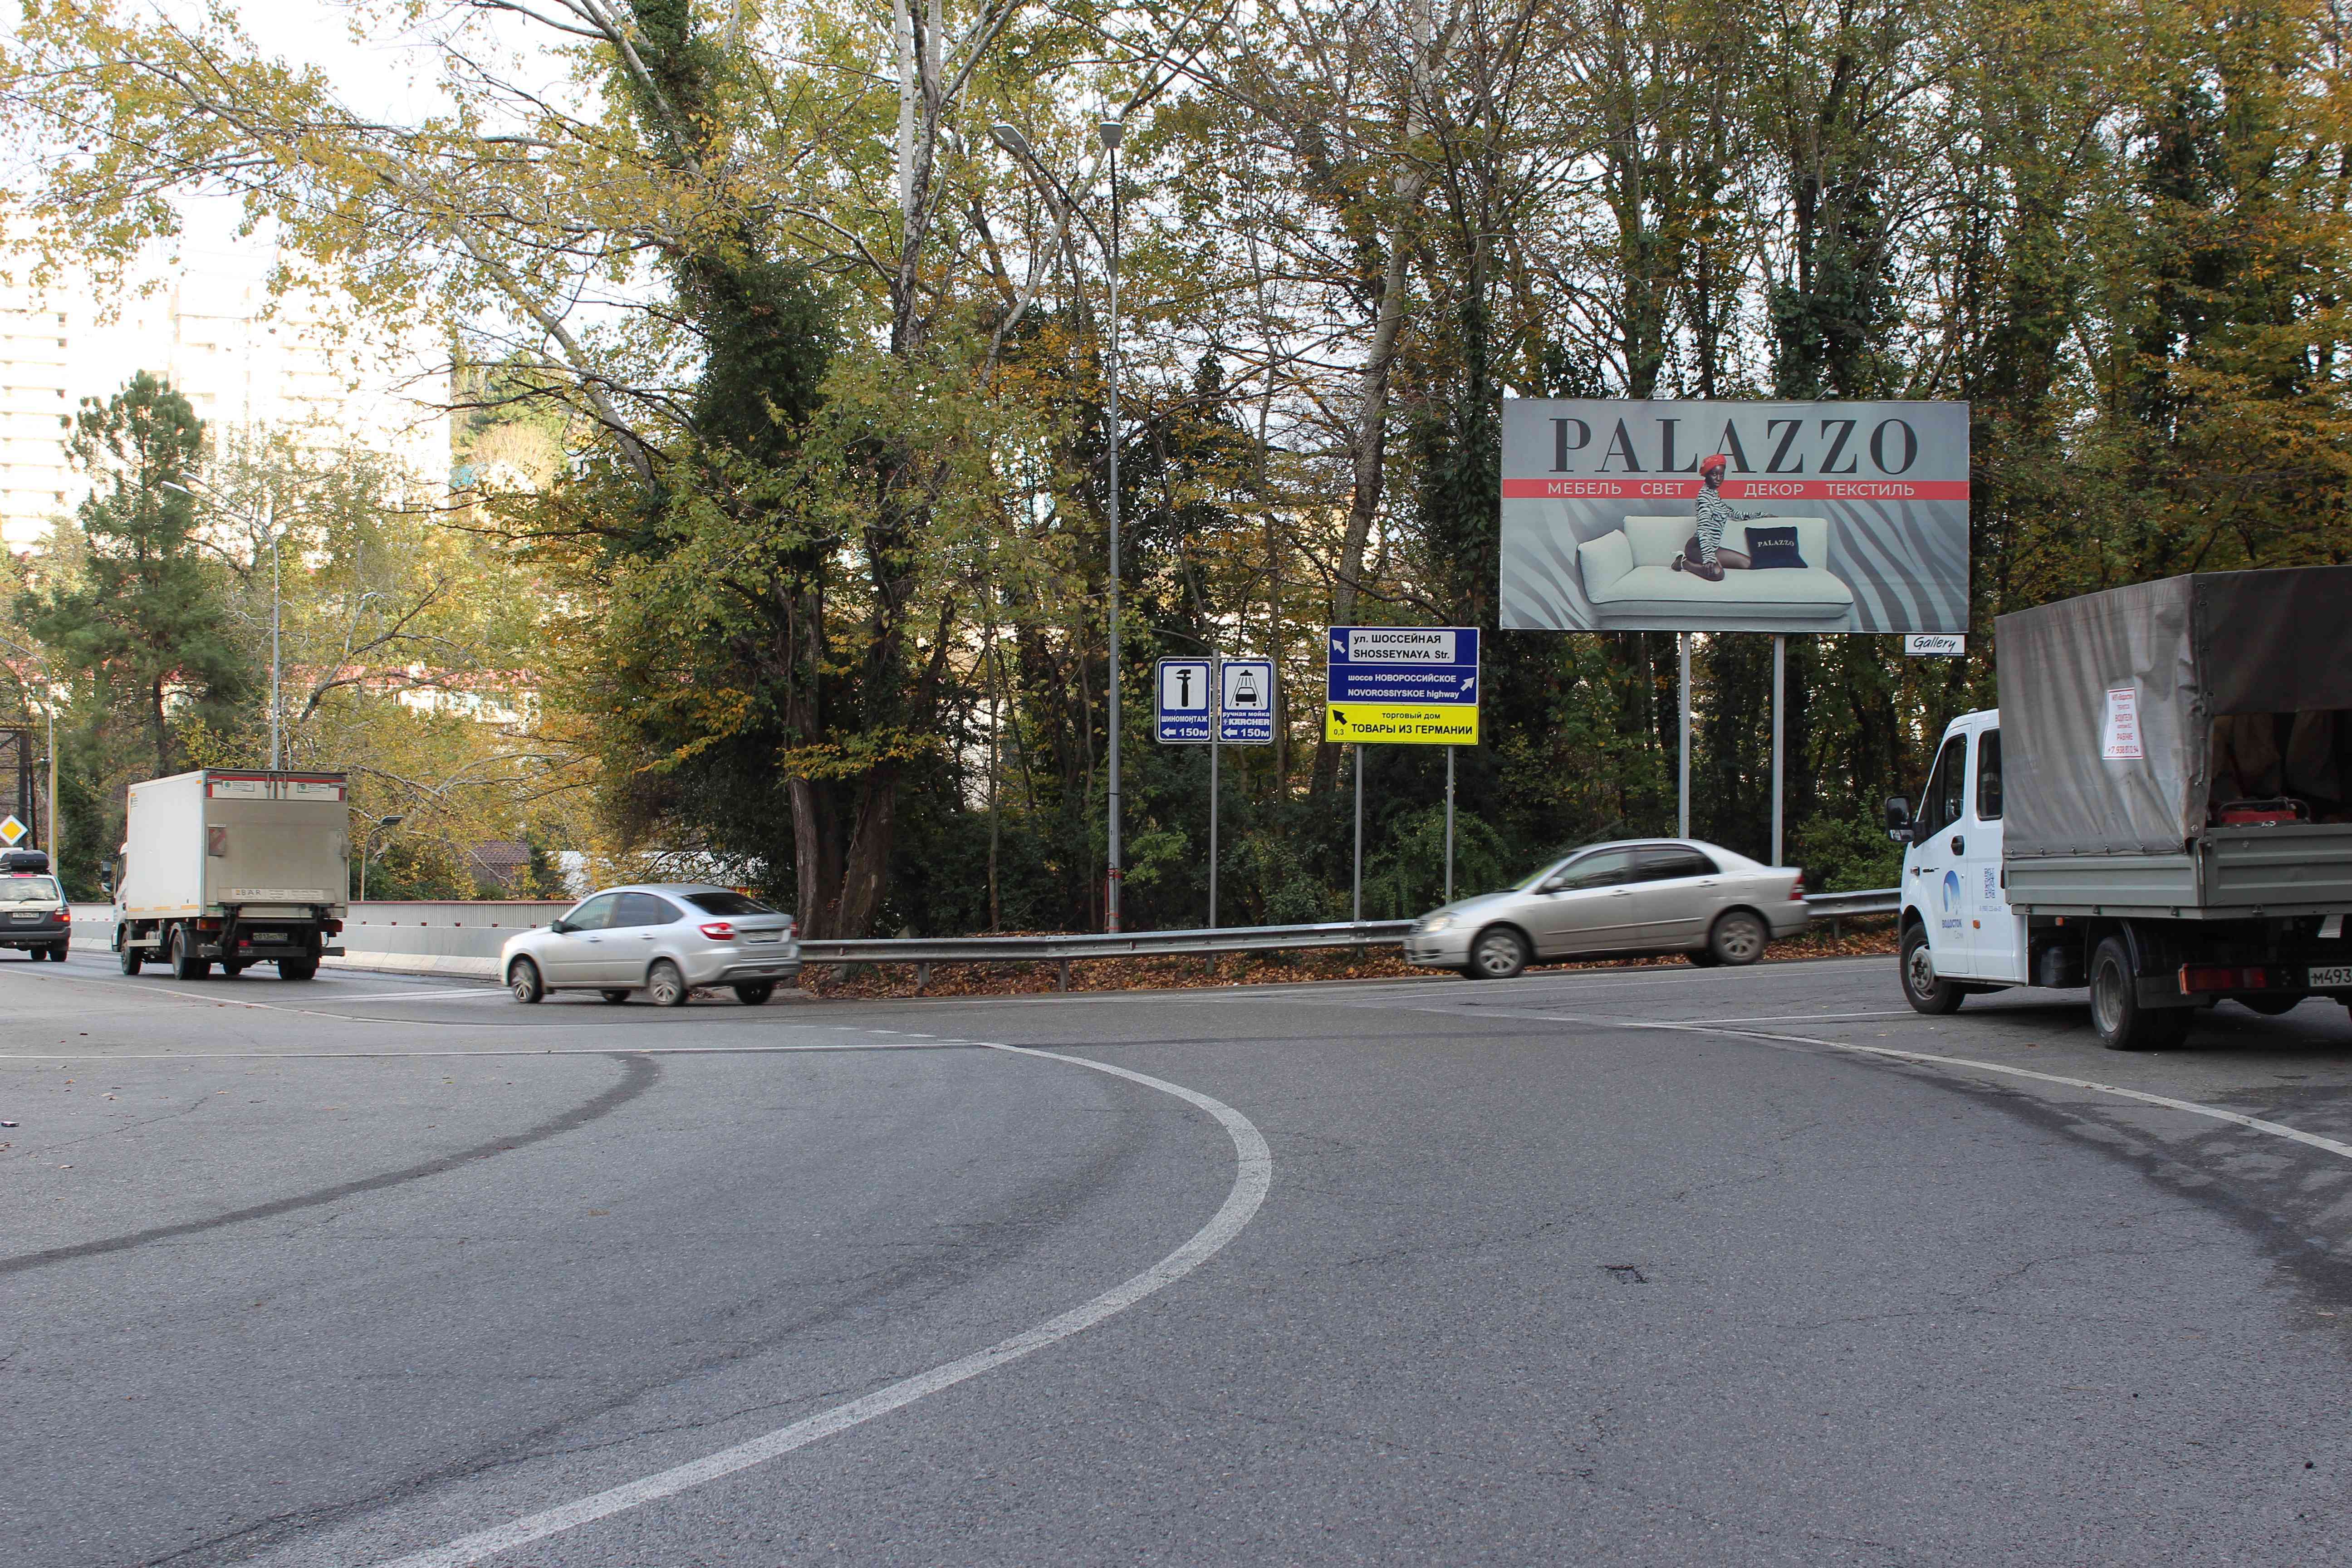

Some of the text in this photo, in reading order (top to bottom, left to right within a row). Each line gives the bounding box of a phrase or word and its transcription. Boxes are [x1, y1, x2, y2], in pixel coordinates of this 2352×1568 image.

[1548, 417, 1918, 475] PALAZZO
[1548, 482, 1915, 497] МЕБЕЛЬ СВЕТ ДЕКОР ТЕКСТИЛЬ
[1354, 633, 1441, 644] ул. ШОССЕЙНАЯ
[1913, 637, 1956, 652] Gallery
[1354, 650, 1450, 659] SHOSSEYNAYA Str.
[1375, 673, 1456, 682] НОВОРОССИЙСКОЕ
[1348, 689, 1459, 699] NOVOROSSIYSKOE highway
[1161, 715, 1208, 724] ШИНОМОНТАЖ
[1179, 728, 1208, 736] 150м
[1240, 728, 1269, 737] 150м
[1352, 724, 1472, 734] ТОВАРЫ ИЗ ГЕРМАНИИ
